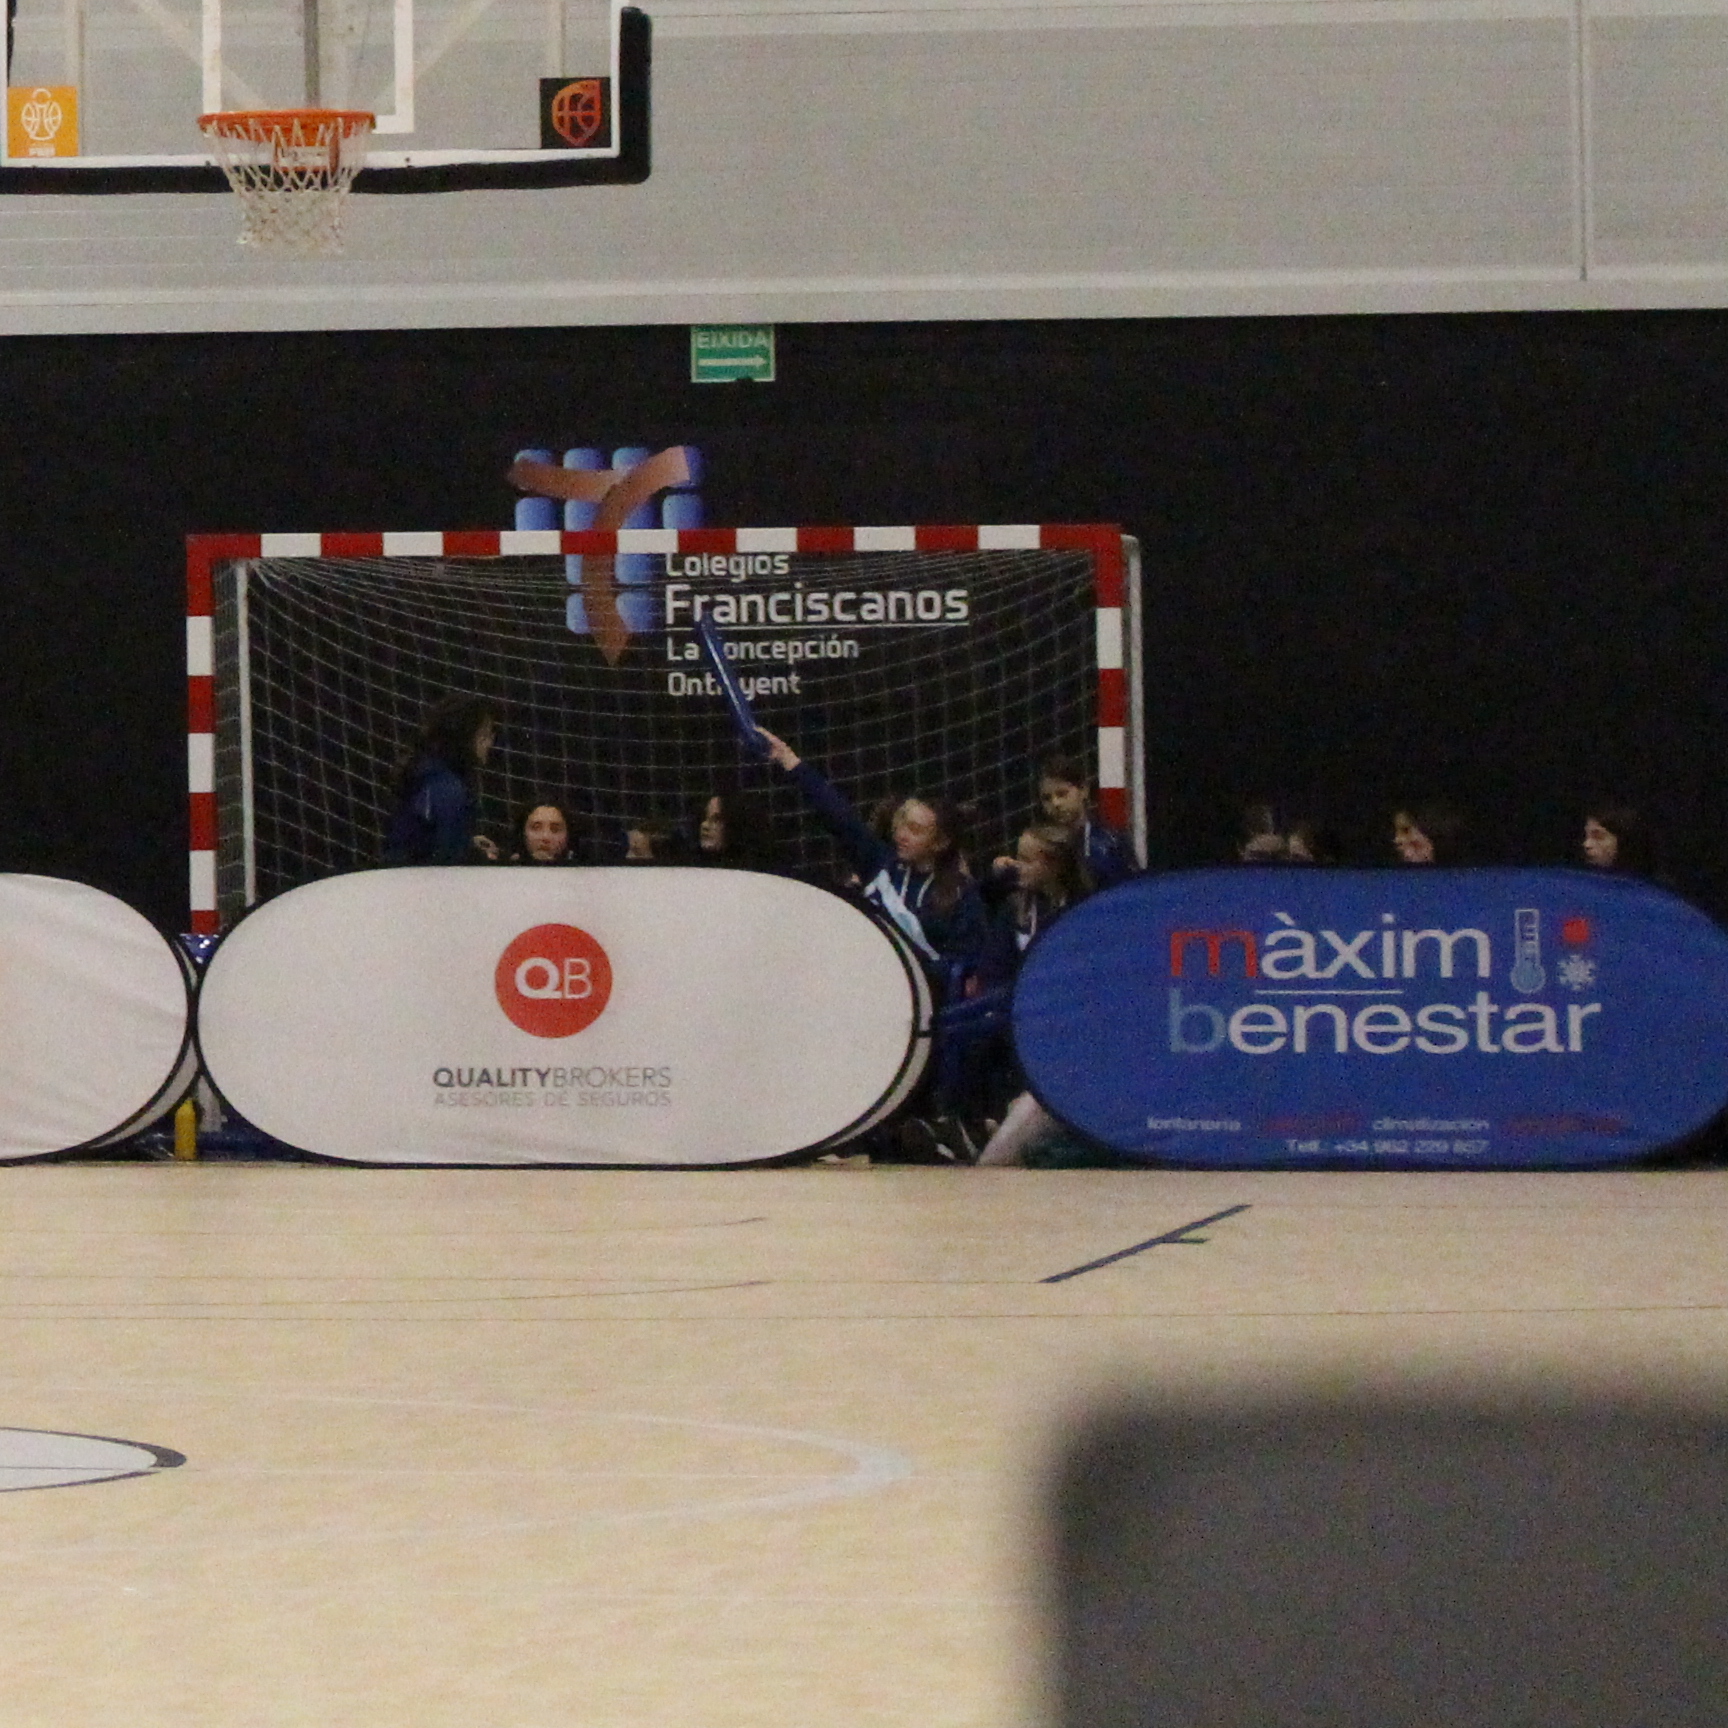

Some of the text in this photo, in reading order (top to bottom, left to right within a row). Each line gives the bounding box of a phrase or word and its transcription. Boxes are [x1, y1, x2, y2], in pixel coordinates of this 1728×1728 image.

[664, 552, 790, 584] Colegios
[664, 581, 970, 624] Franciscanos
[666, 633, 860, 665] La oncepción
[666, 670, 802, 701] Ontyent
[1169, 911, 1492, 980] màxim
[514, 956, 593, 1000] QB
[1168, 987, 1602, 1055] benestar
[432, 1067, 672, 1089] QUALITYBROKERS
[544, 1091, 572, 1107] DE
[576, 1090, 672, 1107] SEGUROS
